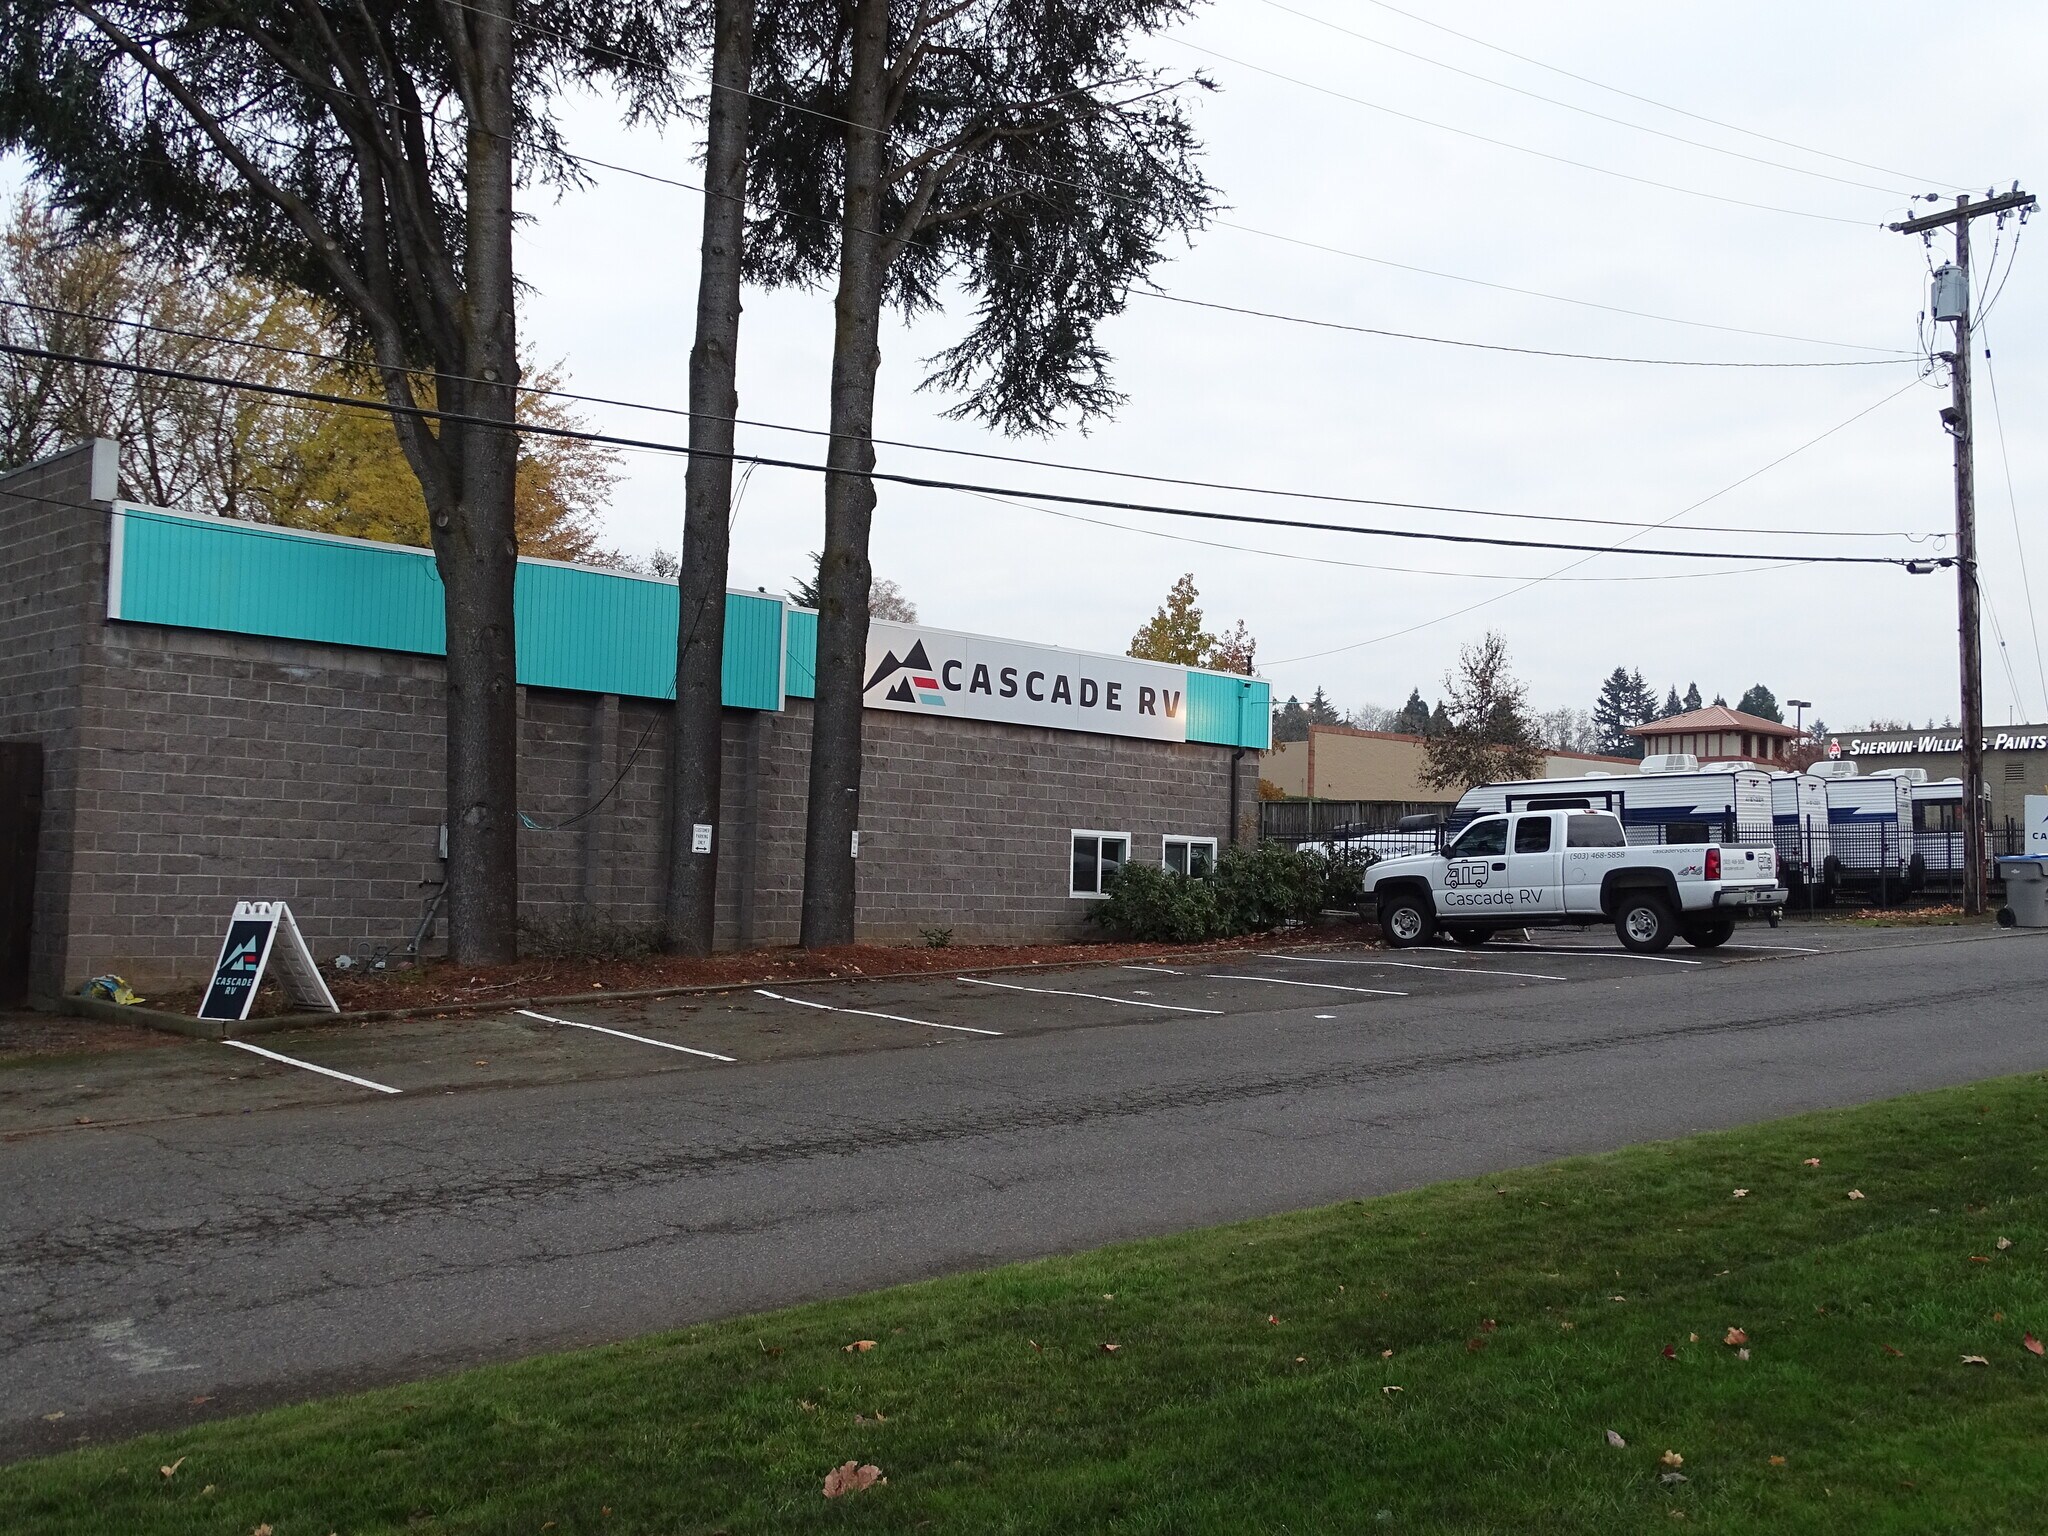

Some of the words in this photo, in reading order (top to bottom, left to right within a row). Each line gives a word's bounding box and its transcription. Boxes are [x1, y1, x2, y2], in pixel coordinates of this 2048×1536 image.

[942, 660, 1122, 711] CASCADE
[1138, 686, 1181, 719] RV
[1850, 736, 1988, 756] SHERWIN-WILLIAS
[1994, 733, 2047, 750] PAINTS
[1569, 852, 1589, 861] (503)
[1590, 851, 1625, 859] 468-5858
[1445, 889, 1514, 906] Cascade
[1519, 889, 1543, 904] RV
[215, 977, 253, 986] CASCADE
[224, 986, 237, 995] RV
